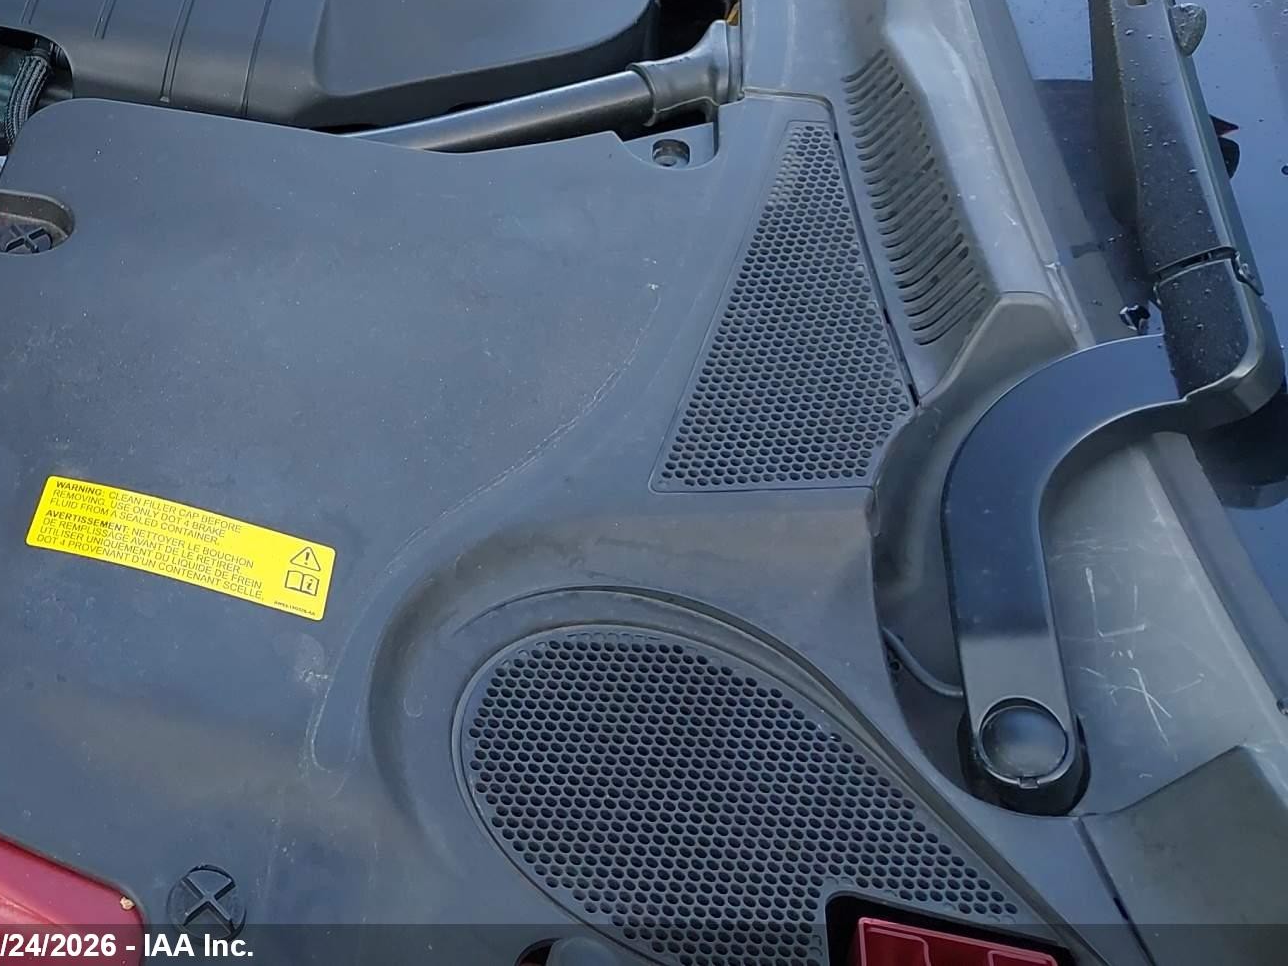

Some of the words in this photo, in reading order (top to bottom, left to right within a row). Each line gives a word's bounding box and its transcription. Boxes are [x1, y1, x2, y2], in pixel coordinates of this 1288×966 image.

[50, 497, 78, 509] FLUID
[80, 503, 109, 515] FROM
[110, 509, 118, 517] A
[119, 511, 158, 527] SEALED
[160, 521, 220, 545] CONTAINER.
[56, 481, 105, 496] WARNING:
[109, 491, 141, 504] CLEAN
[144, 499, 175, 513] FILLER
[179, 508, 199, 520] CAP
[202, 515, 241, 533] BEFORE
[110, 500, 129, 511] USE
[132, 505, 158, 518] ONLY
[161, 513, 181, 524] DOT
[192, 521, 225, 537] BRAKE
[37, 533, 57, 544] DOT
[58, 538, 66, 546] 4
[68, 540, 129, 560] PROVENANT
[132, 555, 155, 567] D'UN
[158, 562, 220, 586] CONTENANT
[40, 525, 84, 541] UTILISER
[86, 535, 151, 557] UNIQUEMENT
[155, 552, 169, 562] DU
[172, 557, 212, 574] LIQUIDE
[214, 569, 227, 579] DE
[232, 574, 261, 589] FREIN
[43, 517, 57, 526] DE
[59, 520, 129, 542] REMPLISSAGE
[131, 536, 161, 550] AVANT
[165, 545, 179, 555] DE
[181, 550, 193, 559] LE
[46, 509, 129, 533] AVERTISSEMENT:
[132, 527, 184, 548] NETTOYER
[187, 542, 200, 552] LE
[202, 546, 253, 568] BOUCHON
